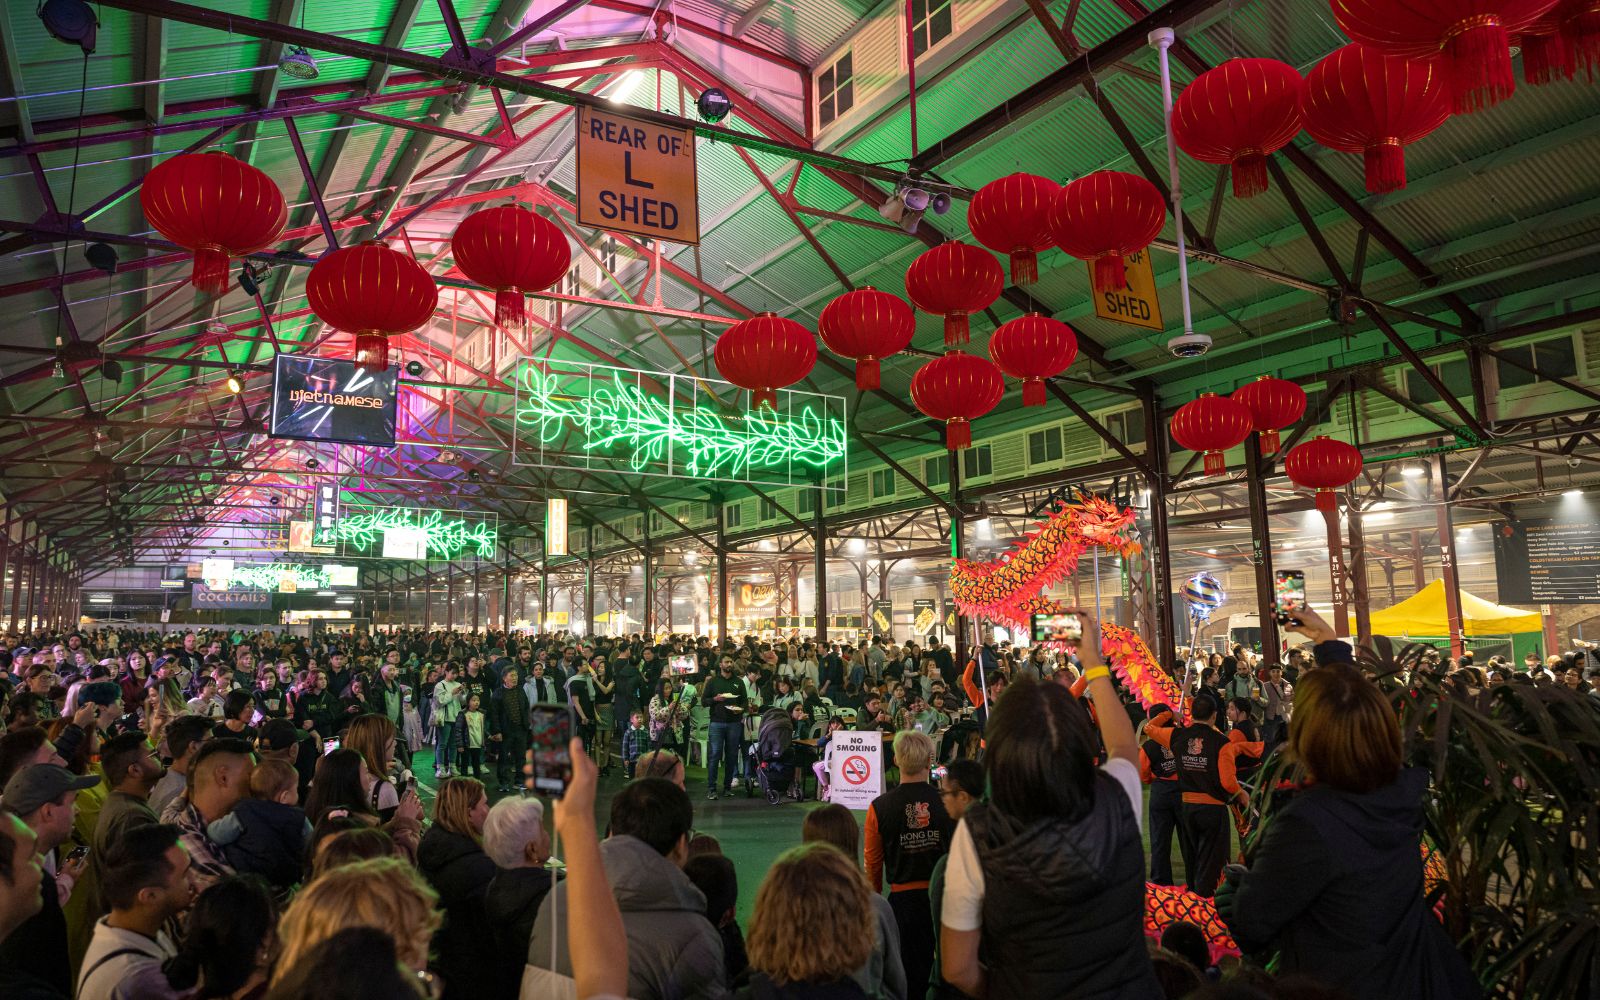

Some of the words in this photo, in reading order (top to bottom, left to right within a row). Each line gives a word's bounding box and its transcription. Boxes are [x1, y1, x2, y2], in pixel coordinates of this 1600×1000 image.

[590, 118, 647, 150] REAR
[657, 134, 682, 157] OF
[624, 150, 654, 190] L
[599, 190, 679, 231] SHED
[1104, 292, 1150, 320] SHED
[1441, 546, 1448, 554] W
[1441, 554, 1450, 562] 59
[198, 592, 267, 603] COCKTAILS
[836, 745, 877, 753] SMOKING
[899, 831, 926, 841] HONG
[927, 830, 940, 838] DE
